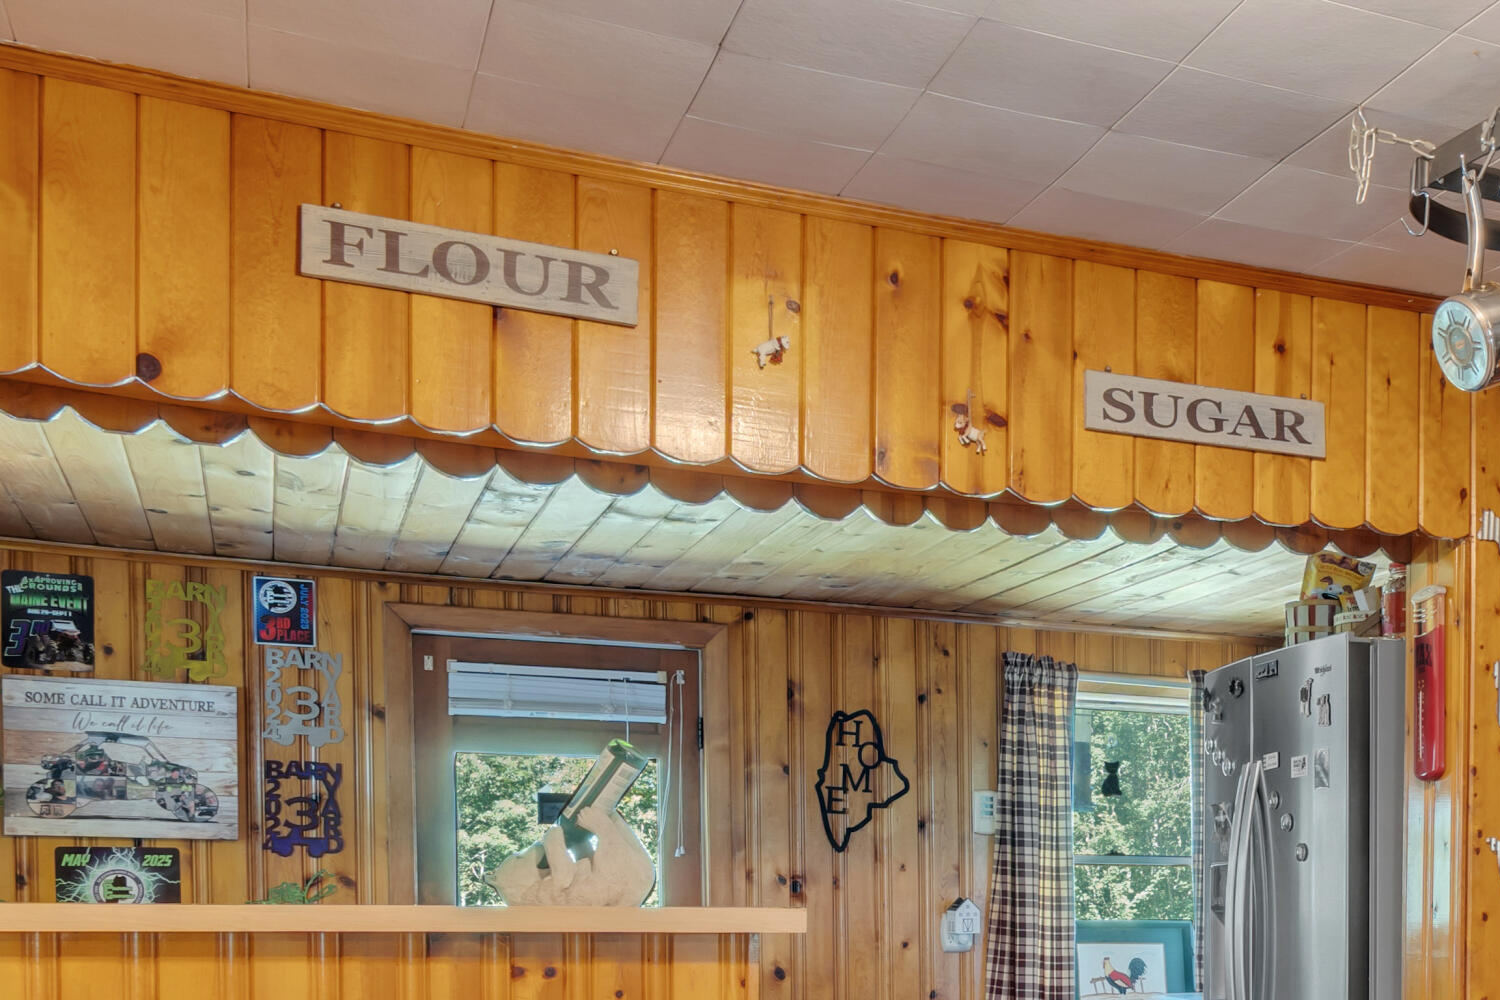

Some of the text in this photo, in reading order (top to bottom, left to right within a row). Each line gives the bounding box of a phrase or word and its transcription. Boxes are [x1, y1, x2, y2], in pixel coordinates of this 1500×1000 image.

[322, 219, 620, 310] FLOUR
[1102, 387, 1312, 445] SUGAR
[166, 618, 201, 653] 3
[277, 629, 310, 641] PLACE
[265, 648, 342, 670] BARN
[24, 691, 216, 713] SOME CALL IT ADVENTURE
[285, 686, 320, 720] 3
[72, 712, 98, 731] We
[102, 714, 131, 732] call
[147, 716, 174, 735] life
[264, 760, 342, 779] BARN
[284, 797, 319, 832] 3
[61, 854, 173, 867] MAY 2025
